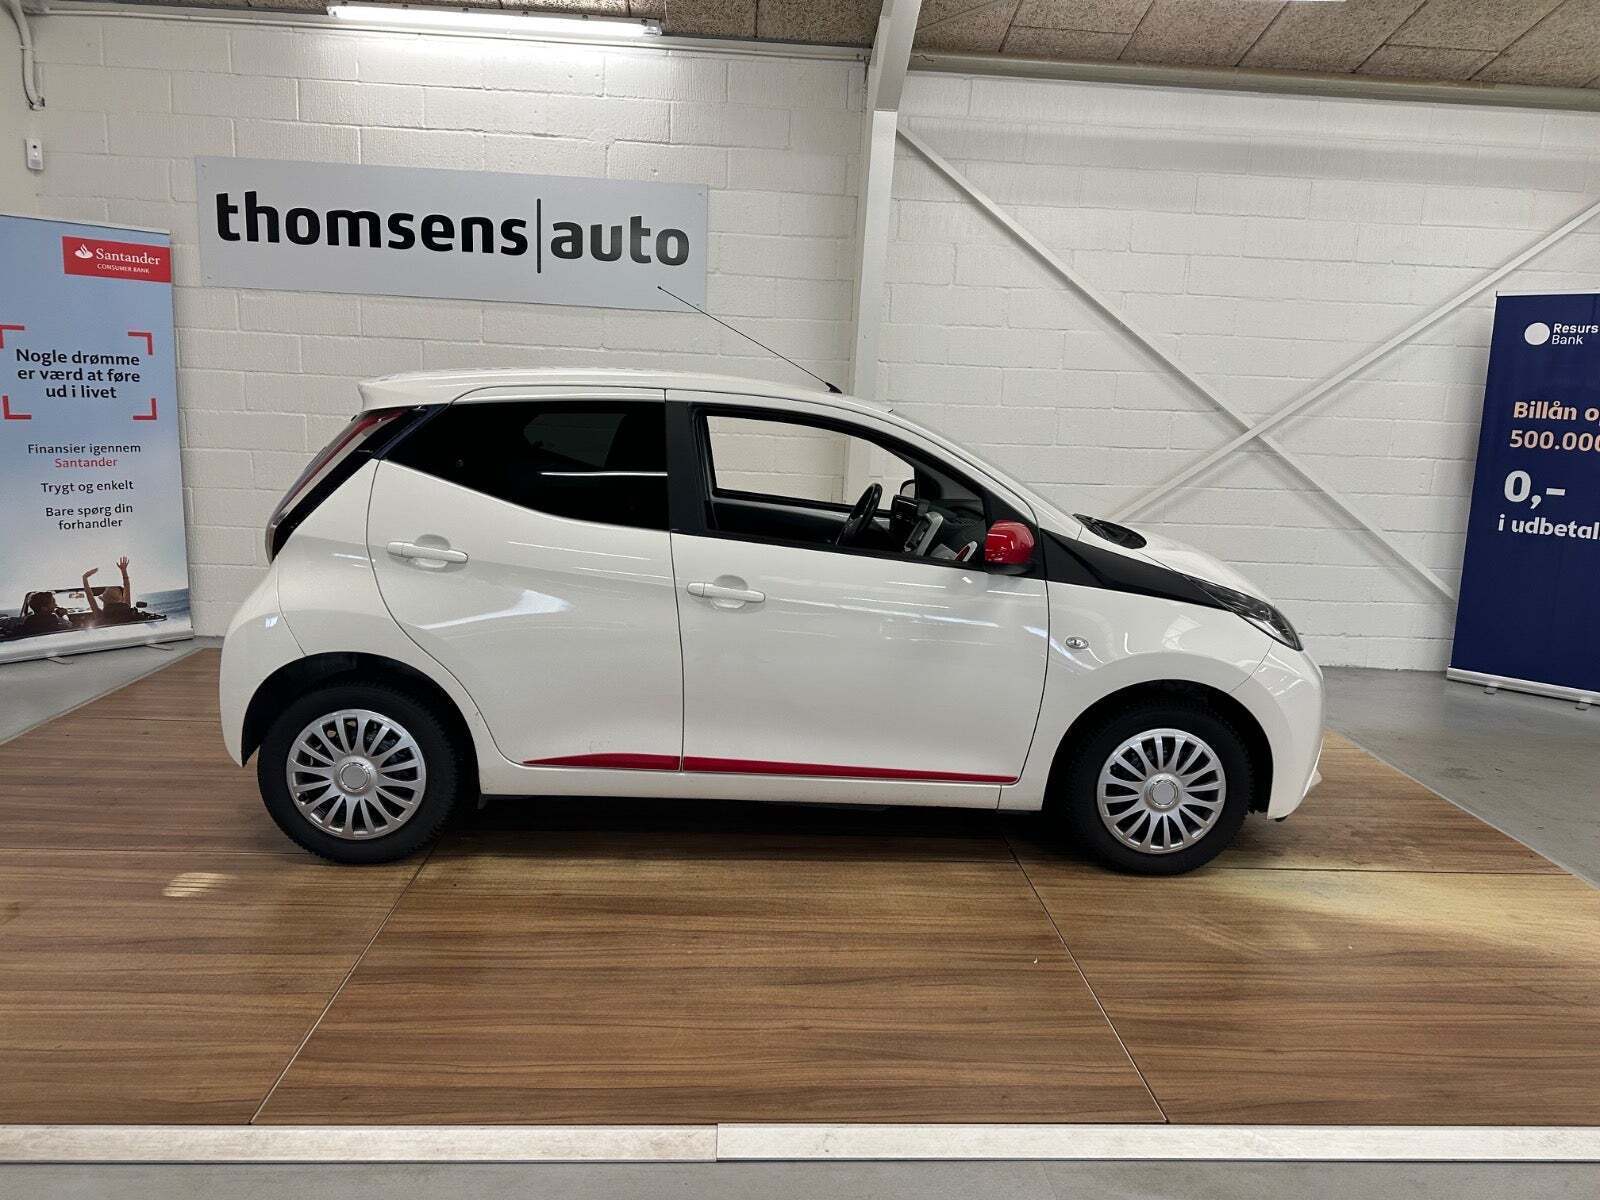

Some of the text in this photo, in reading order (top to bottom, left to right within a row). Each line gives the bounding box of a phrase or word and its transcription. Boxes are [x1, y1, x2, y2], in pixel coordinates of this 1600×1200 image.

[216, 190, 690, 266] thomsens auto
[96, 248, 160, 265] Santander
[97, 263, 150, 274] CONSUMER BANK
[1553, 323, 1599, 334] Resurs
[1551, 334, 1583, 345] Bank
[16, 349, 140, 367] Nogle drømme
[17, 368, 140, 383] er værd at føre
[46, 385, 117, 399] ud i livet
[1513, 400, 1600, 426] Billån o
[28, 443, 141, 455] Finansier igennem
[55, 457, 118, 468] Santander
[41, 479, 134, 494] Trygt og enkelt
[46, 503, 133, 518] Bare spørg din
[58, 518, 123, 530] forhandler
[1498, 513, 1600, 541] i udbetal
